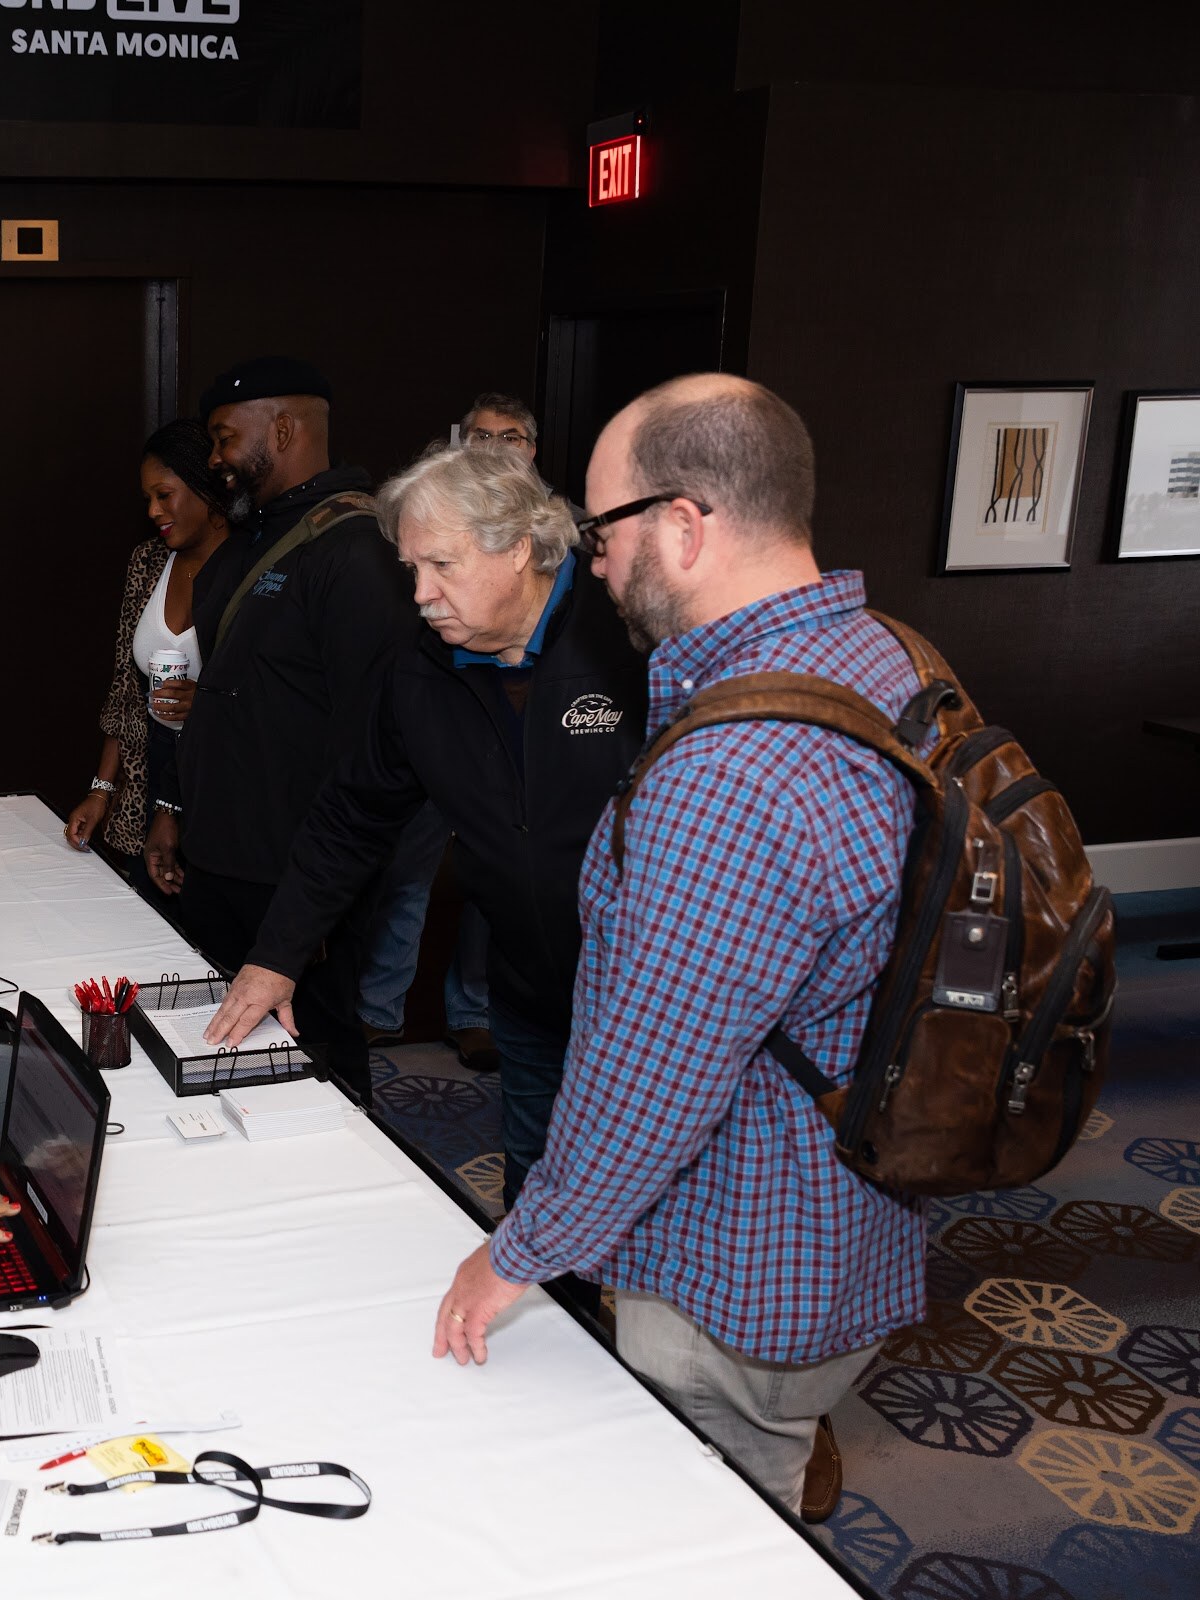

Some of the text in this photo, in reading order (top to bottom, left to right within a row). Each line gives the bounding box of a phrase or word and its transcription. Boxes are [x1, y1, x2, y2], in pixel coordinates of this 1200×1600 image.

[11, 28, 108, 56] SANTA
[116, 32, 239, 60] MONICA
[599, 143, 632, 201] EXIT
[562, 707, 623, 728] Cape May
[570, 727, 604, 736] BREWING
